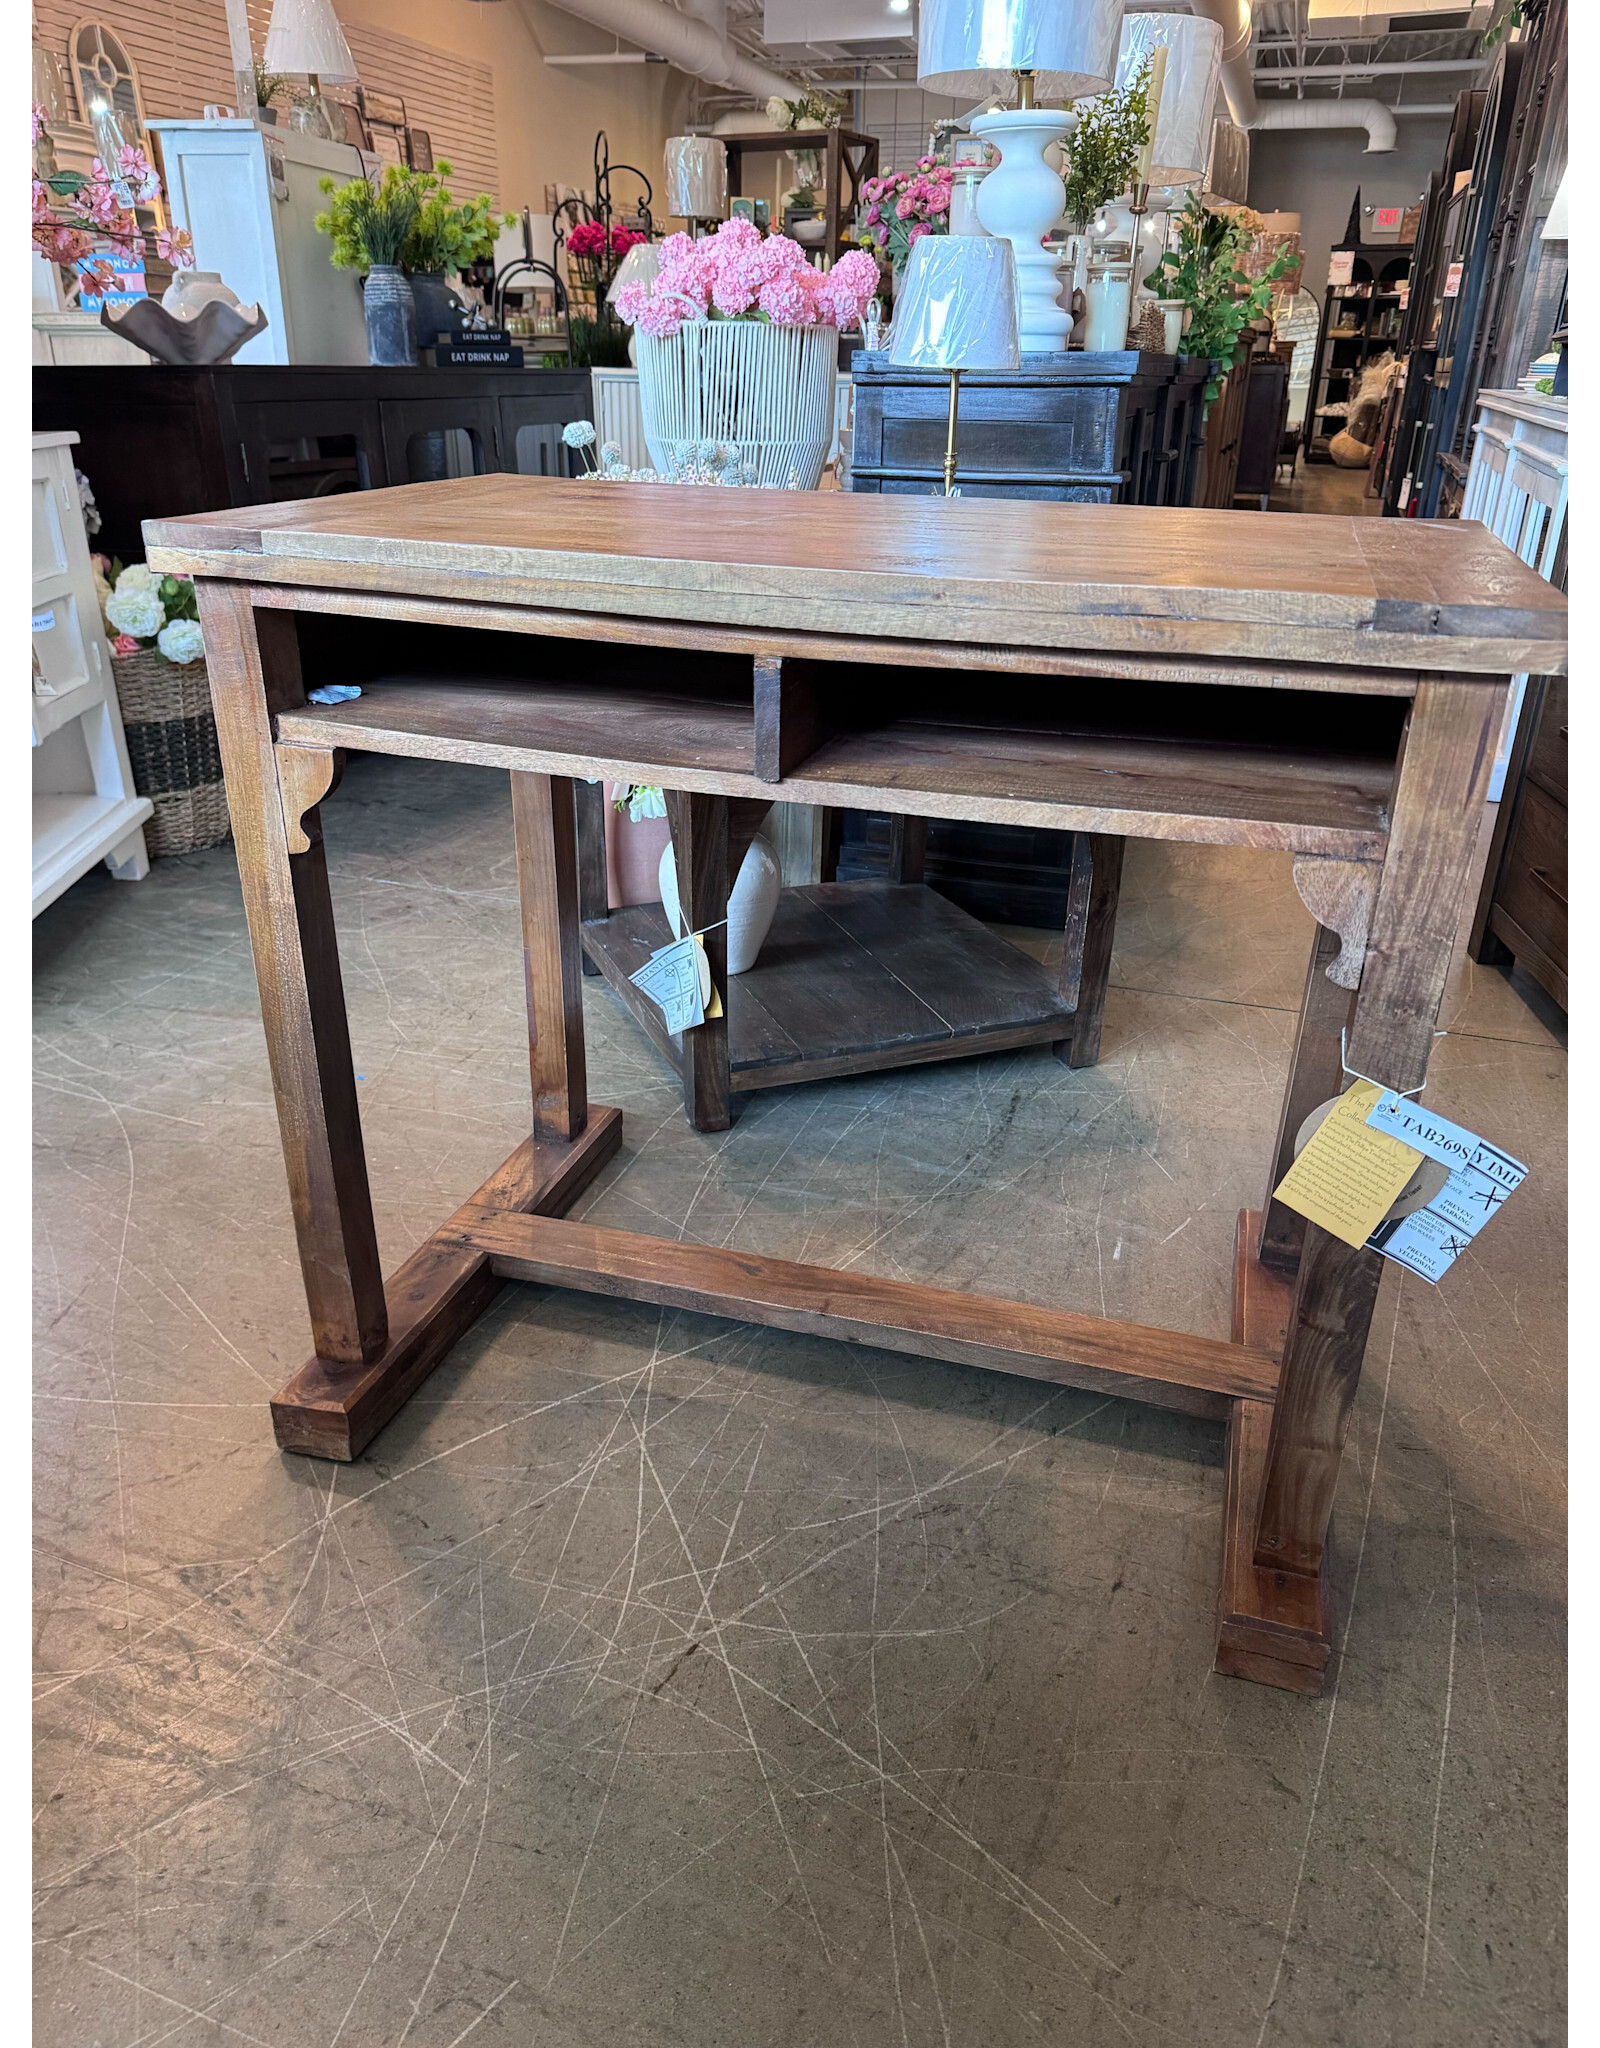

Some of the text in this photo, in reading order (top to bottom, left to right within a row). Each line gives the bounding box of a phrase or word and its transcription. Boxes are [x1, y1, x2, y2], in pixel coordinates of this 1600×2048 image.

[1377, 208, 1399, 225] EXIT
[451, 352, 509, 362] EAT DRINK NAP
[1347, 1092, 1365, 1108] The
[1400, 1116, 1470, 1160] TAB269S
[1488, 1160, 1520, 1187] IMP
[1439, 1204, 1470, 1225] MARKING
[1443, 1199, 1474, 1220] PREVENT
[1405, 1222, 1417, 1231] AND
[1407, 1218, 1433, 1233] POLISHES
[1411, 1213, 1446, 1235] COMMERCIAL
[1398, 1248, 1436, 1274] YELLOWING
[1406, 1245, 1435, 1266] PREVENT
